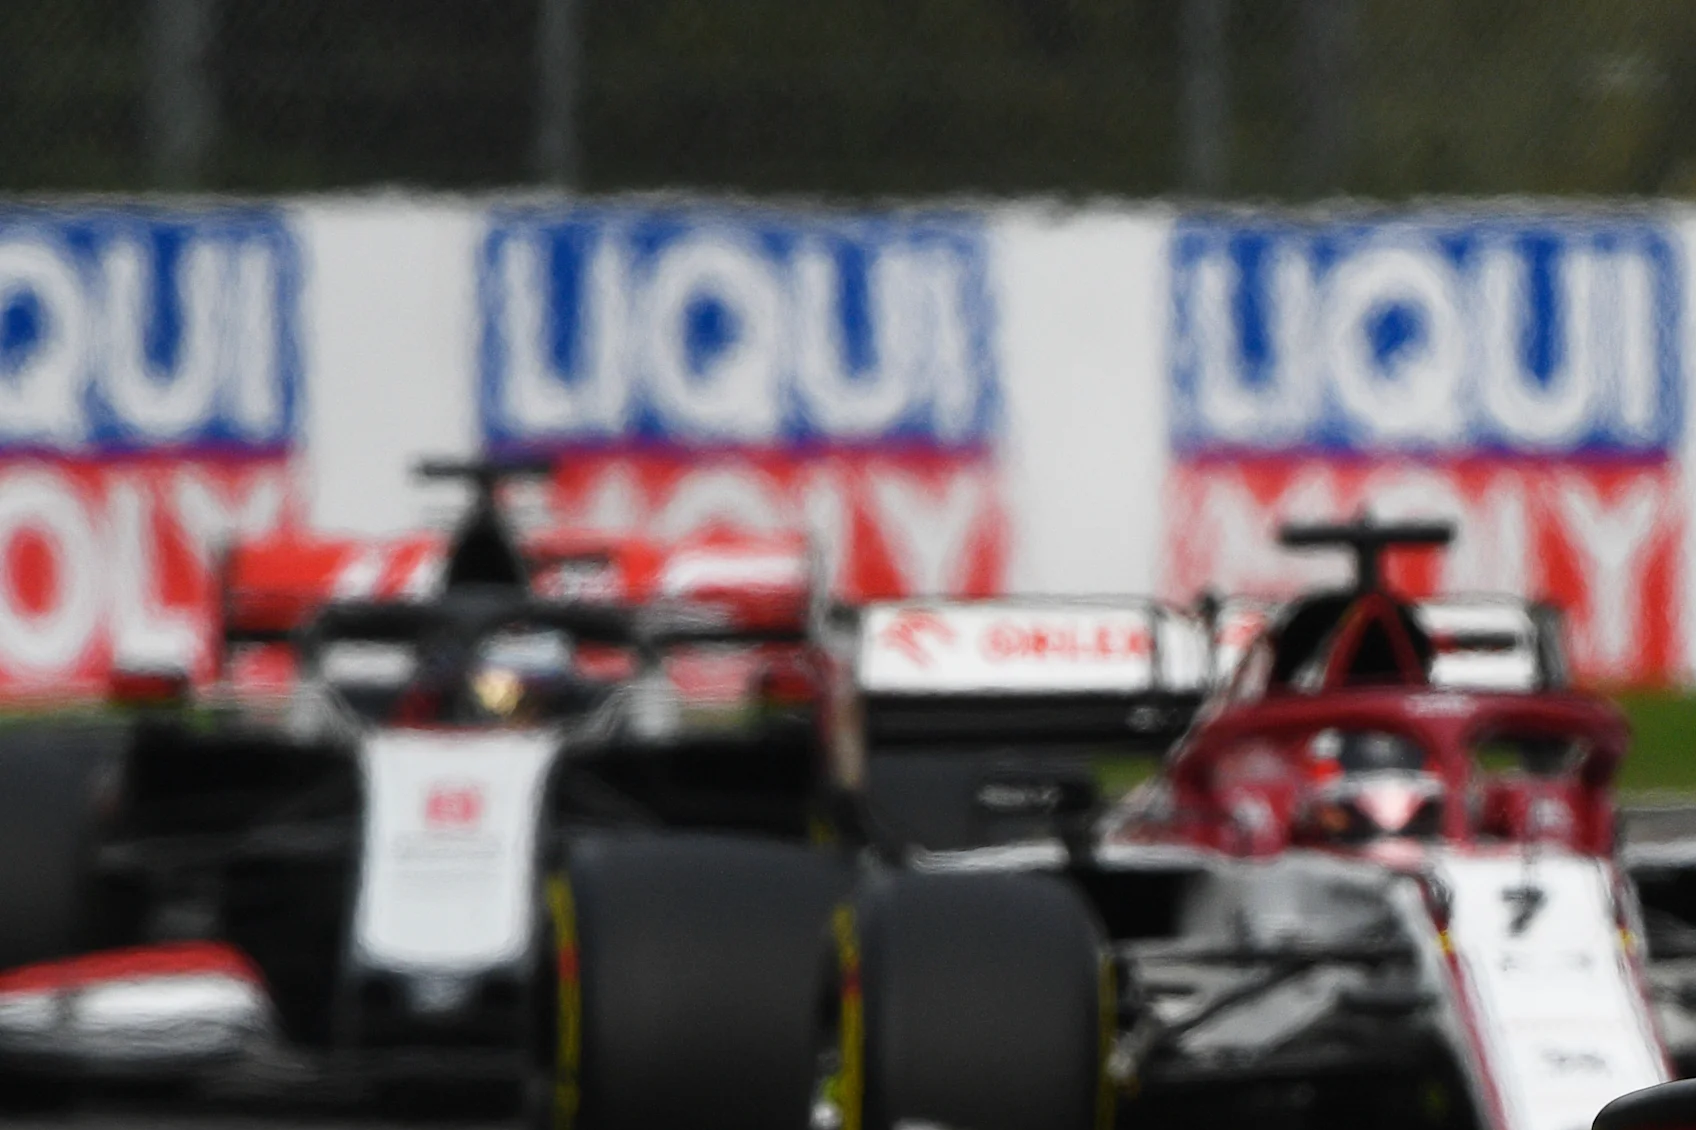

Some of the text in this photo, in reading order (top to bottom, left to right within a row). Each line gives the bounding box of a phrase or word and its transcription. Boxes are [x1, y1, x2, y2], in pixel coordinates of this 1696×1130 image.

[500, 236, 975, 443] LIQUI
[1200, 240, 1657, 444] LIQUI
[1501, 884, 1546, 938] 7
